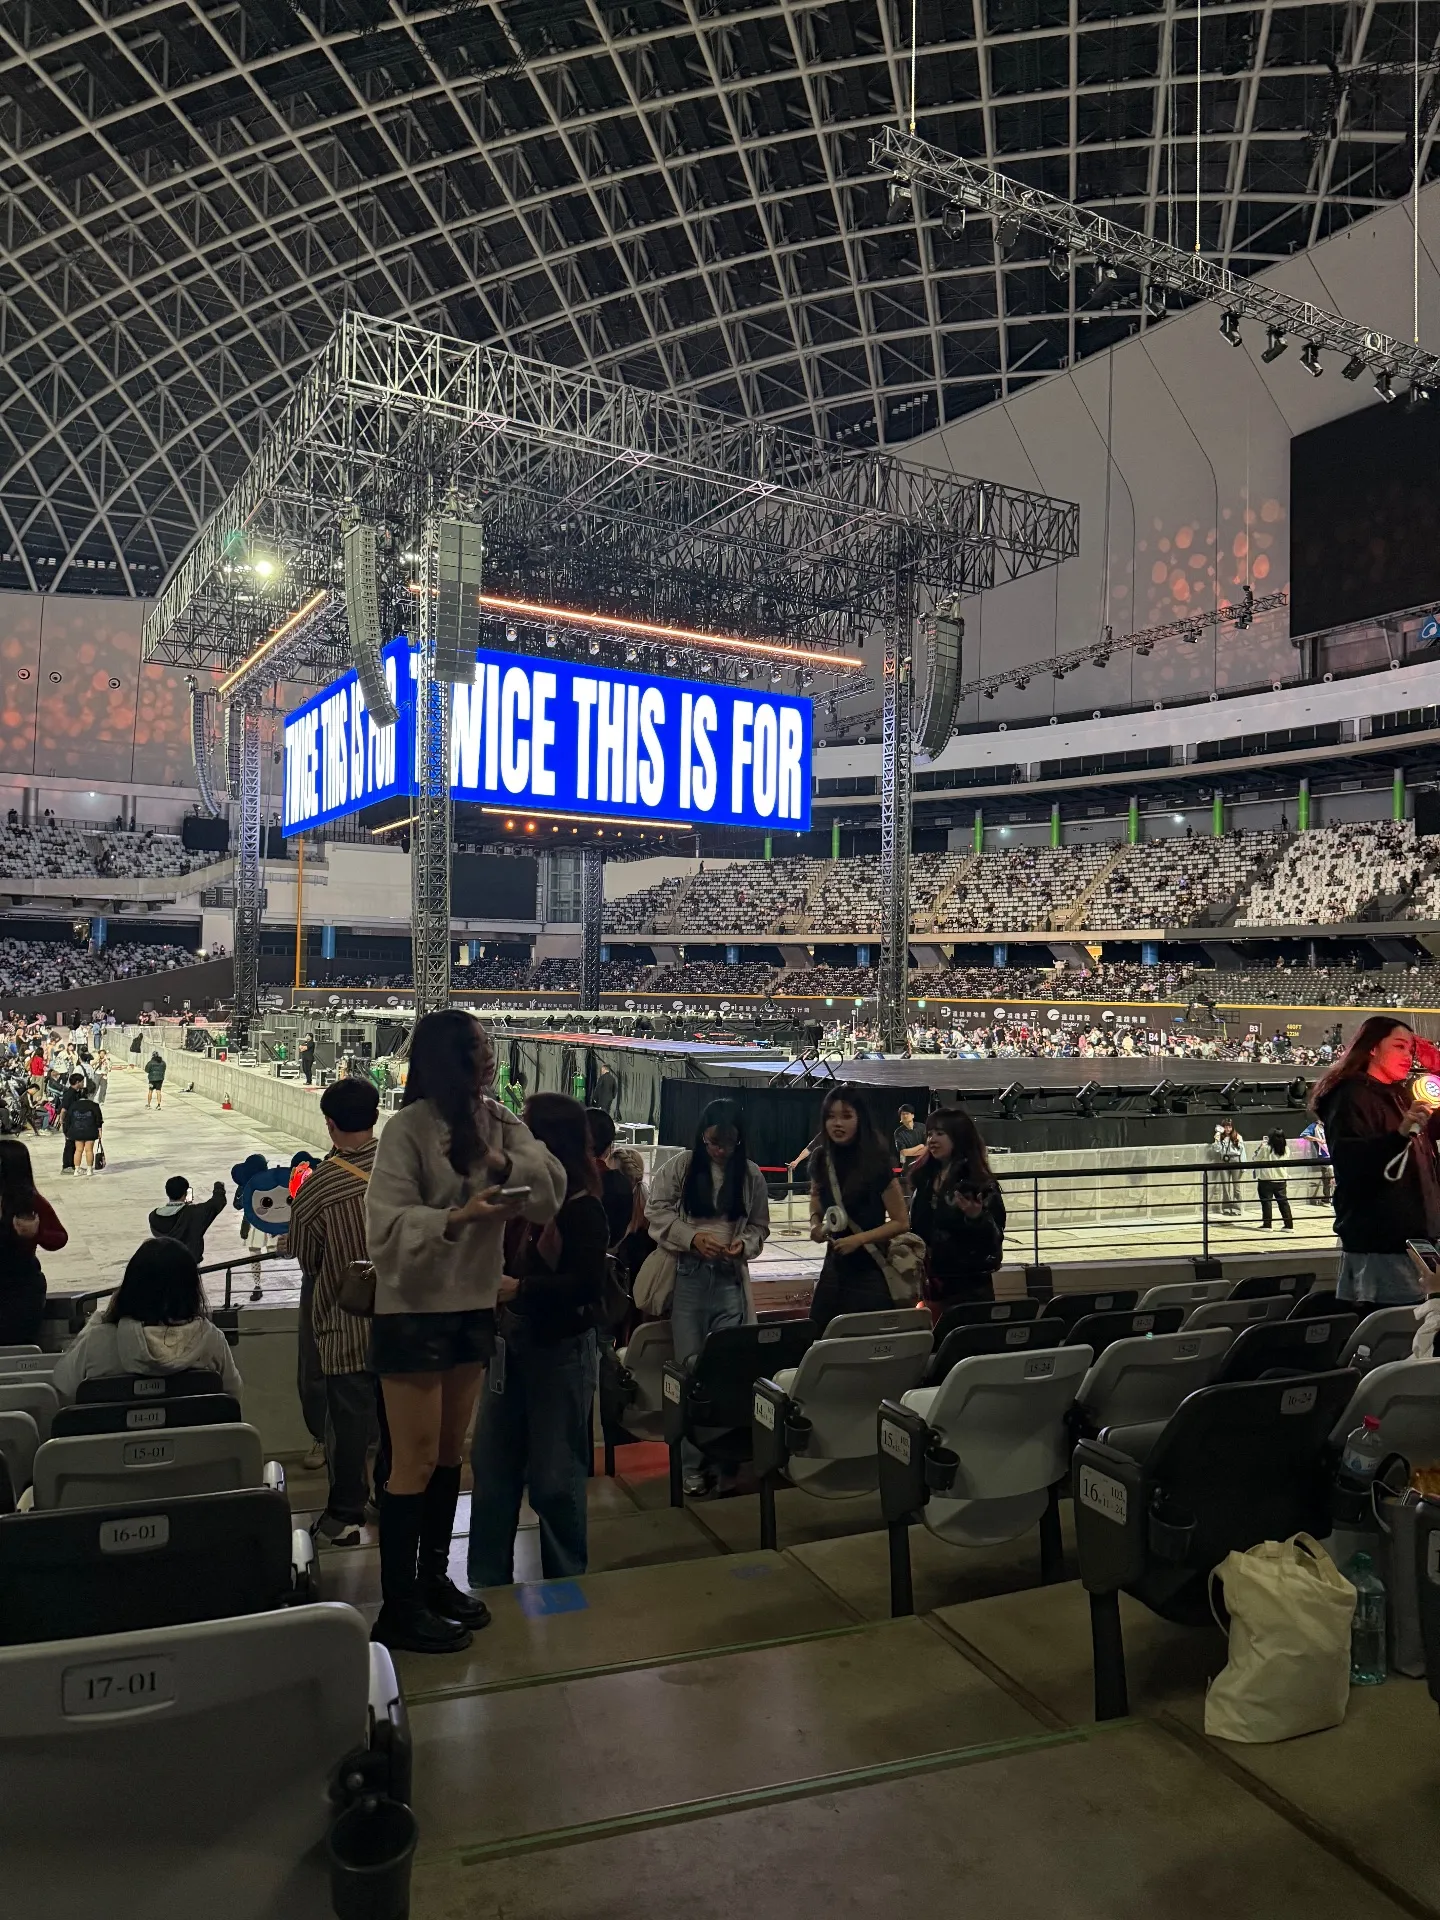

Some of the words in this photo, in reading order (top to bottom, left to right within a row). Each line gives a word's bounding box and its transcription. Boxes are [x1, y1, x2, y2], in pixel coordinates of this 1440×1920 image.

[284, 707, 319, 827] TWICE
[320, 687, 348, 813] THIS
[350, 678, 365, 800] IS
[572, 676, 666, 807] THIS
[680, 692, 718, 811] IS
[731, 699, 802, 820] FOR
[1148, 1032, 1159, 1042] B4
[1249, 1024, 1259, 1033] B3
[133, 1411, 160, 1423] 14-01
[882, 1428, 894, 1448] 15
[133, 1446, 165, 1460] 15-01
[1083, 1477, 1099, 1502] 16
[112, 1524, 156, 1543] 16-01
[85, 1671, 157, 1701] 17-01
